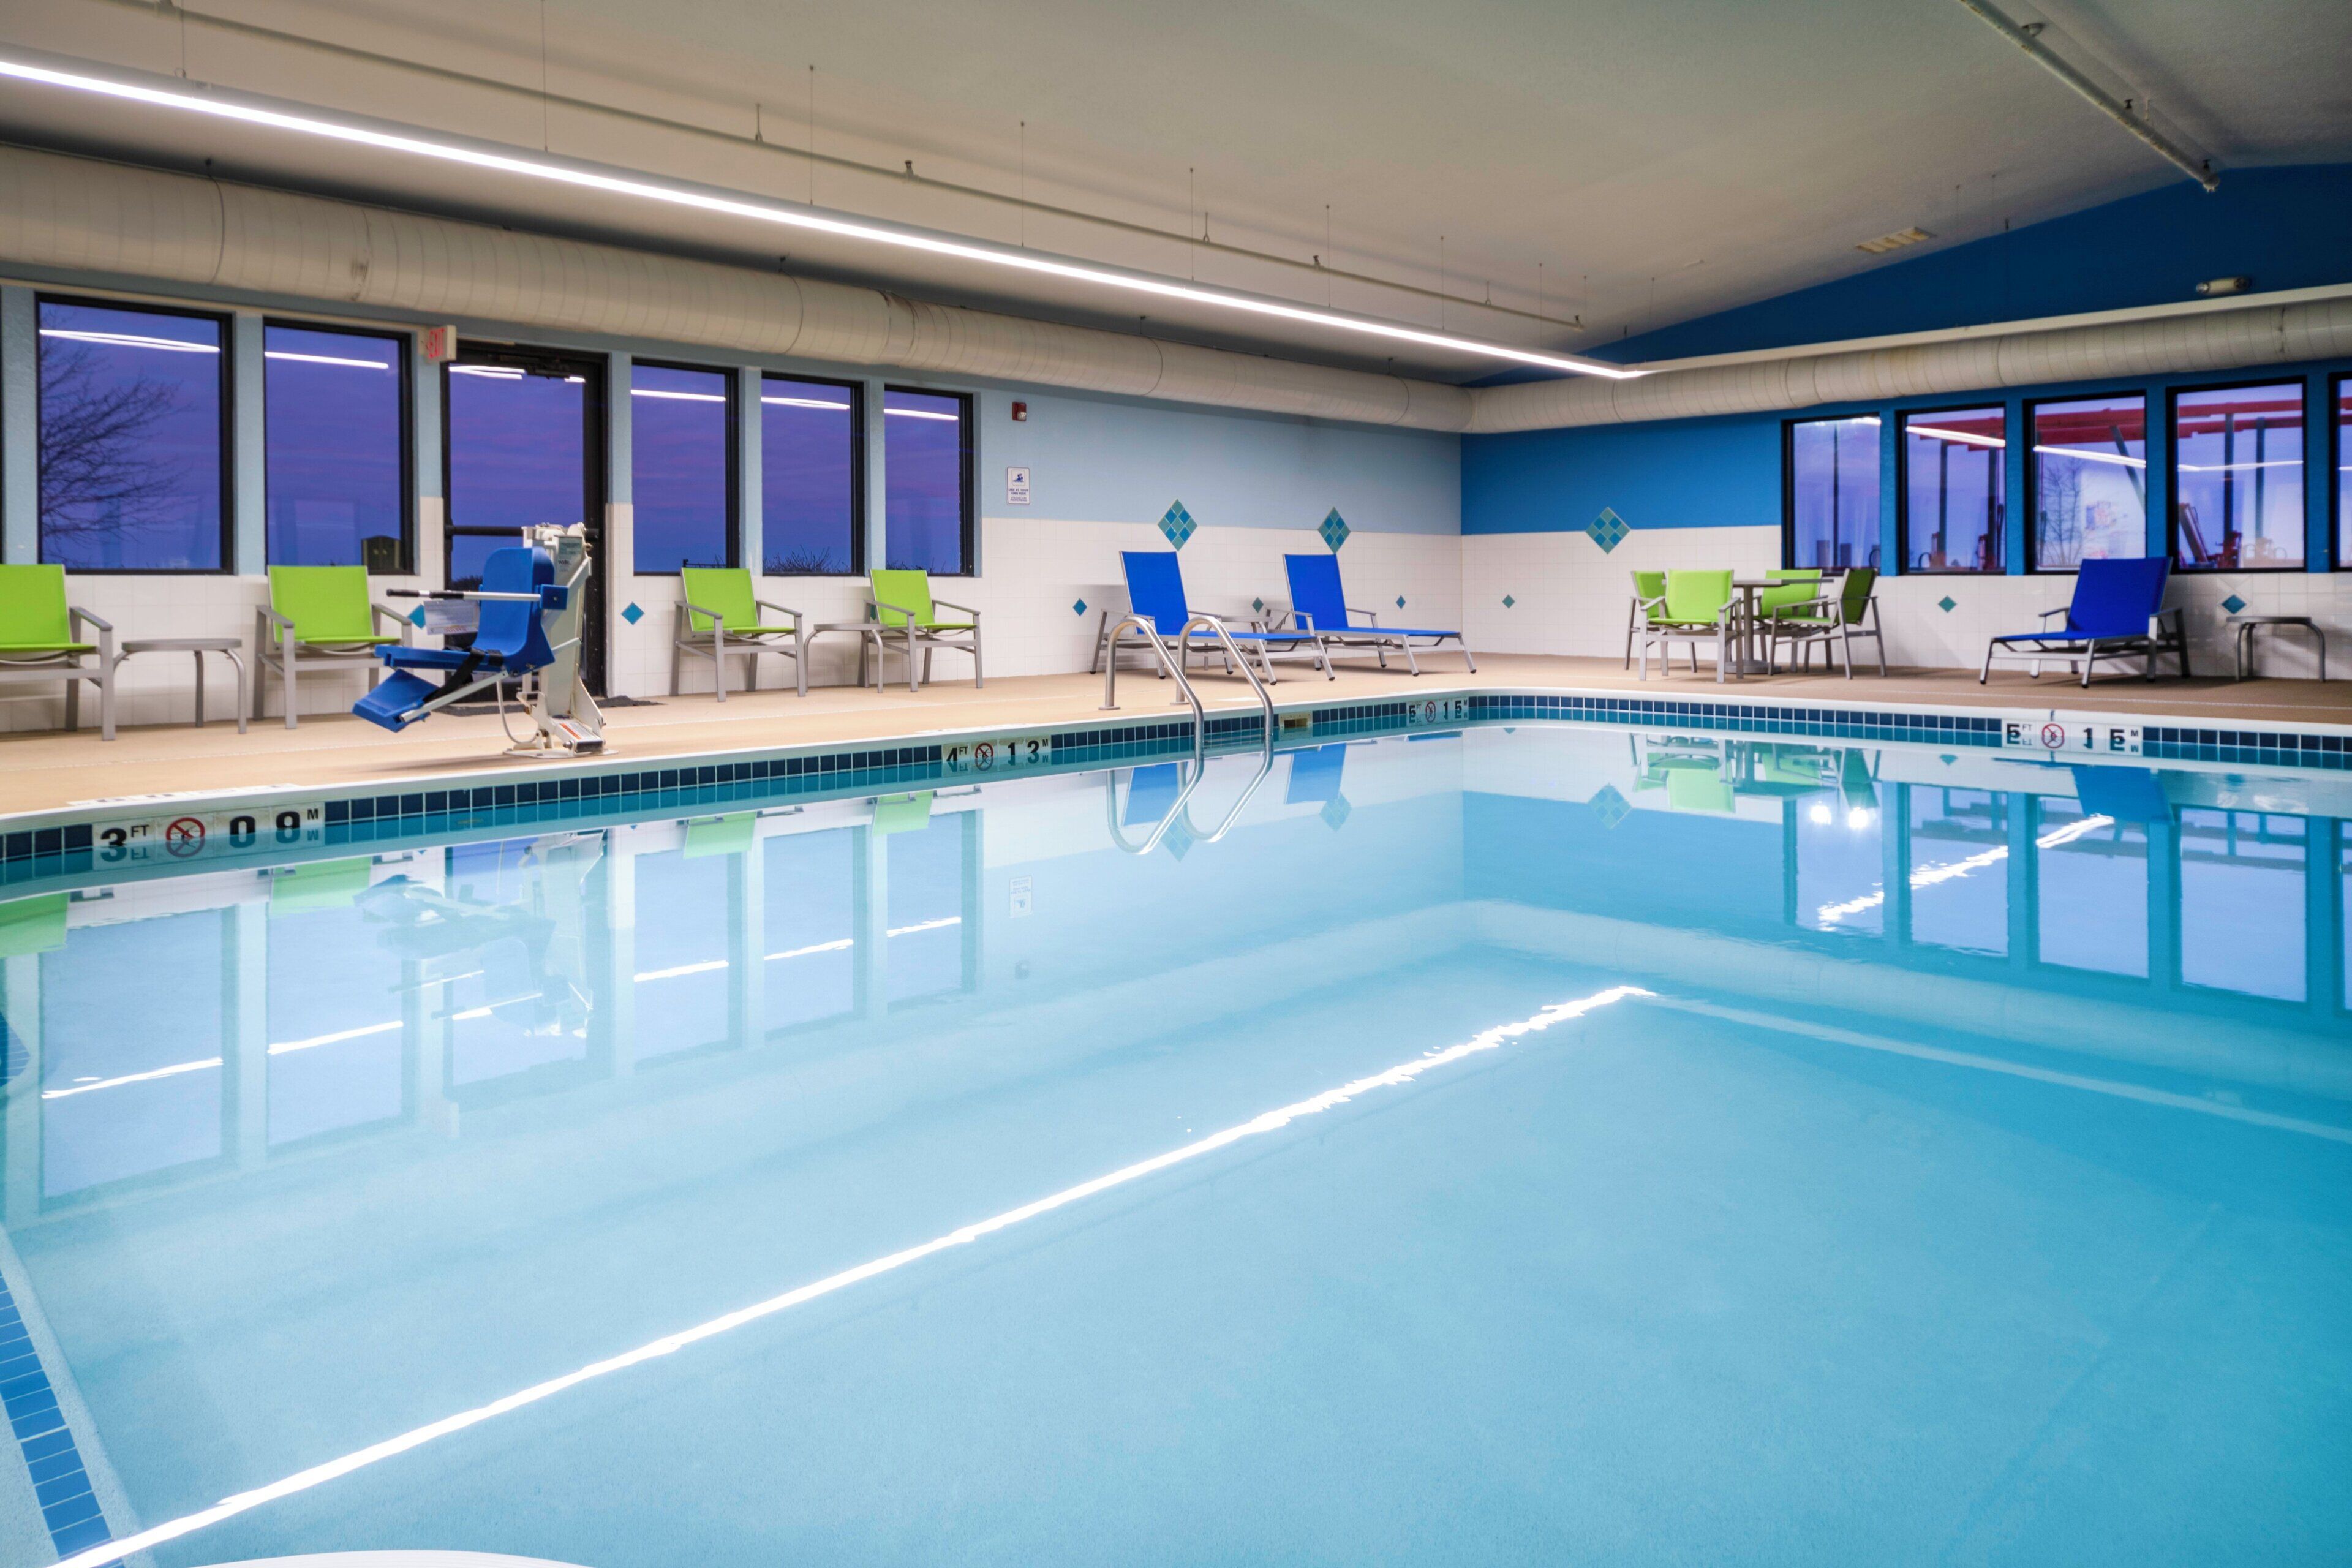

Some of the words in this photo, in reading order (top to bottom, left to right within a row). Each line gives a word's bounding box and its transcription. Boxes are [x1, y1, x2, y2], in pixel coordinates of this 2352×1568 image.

[959, 746, 968, 755] FT
[1042, 739, 1049, 747] M
[130, 824, 149, 839] FT
[307, 809, 319, 820] M
